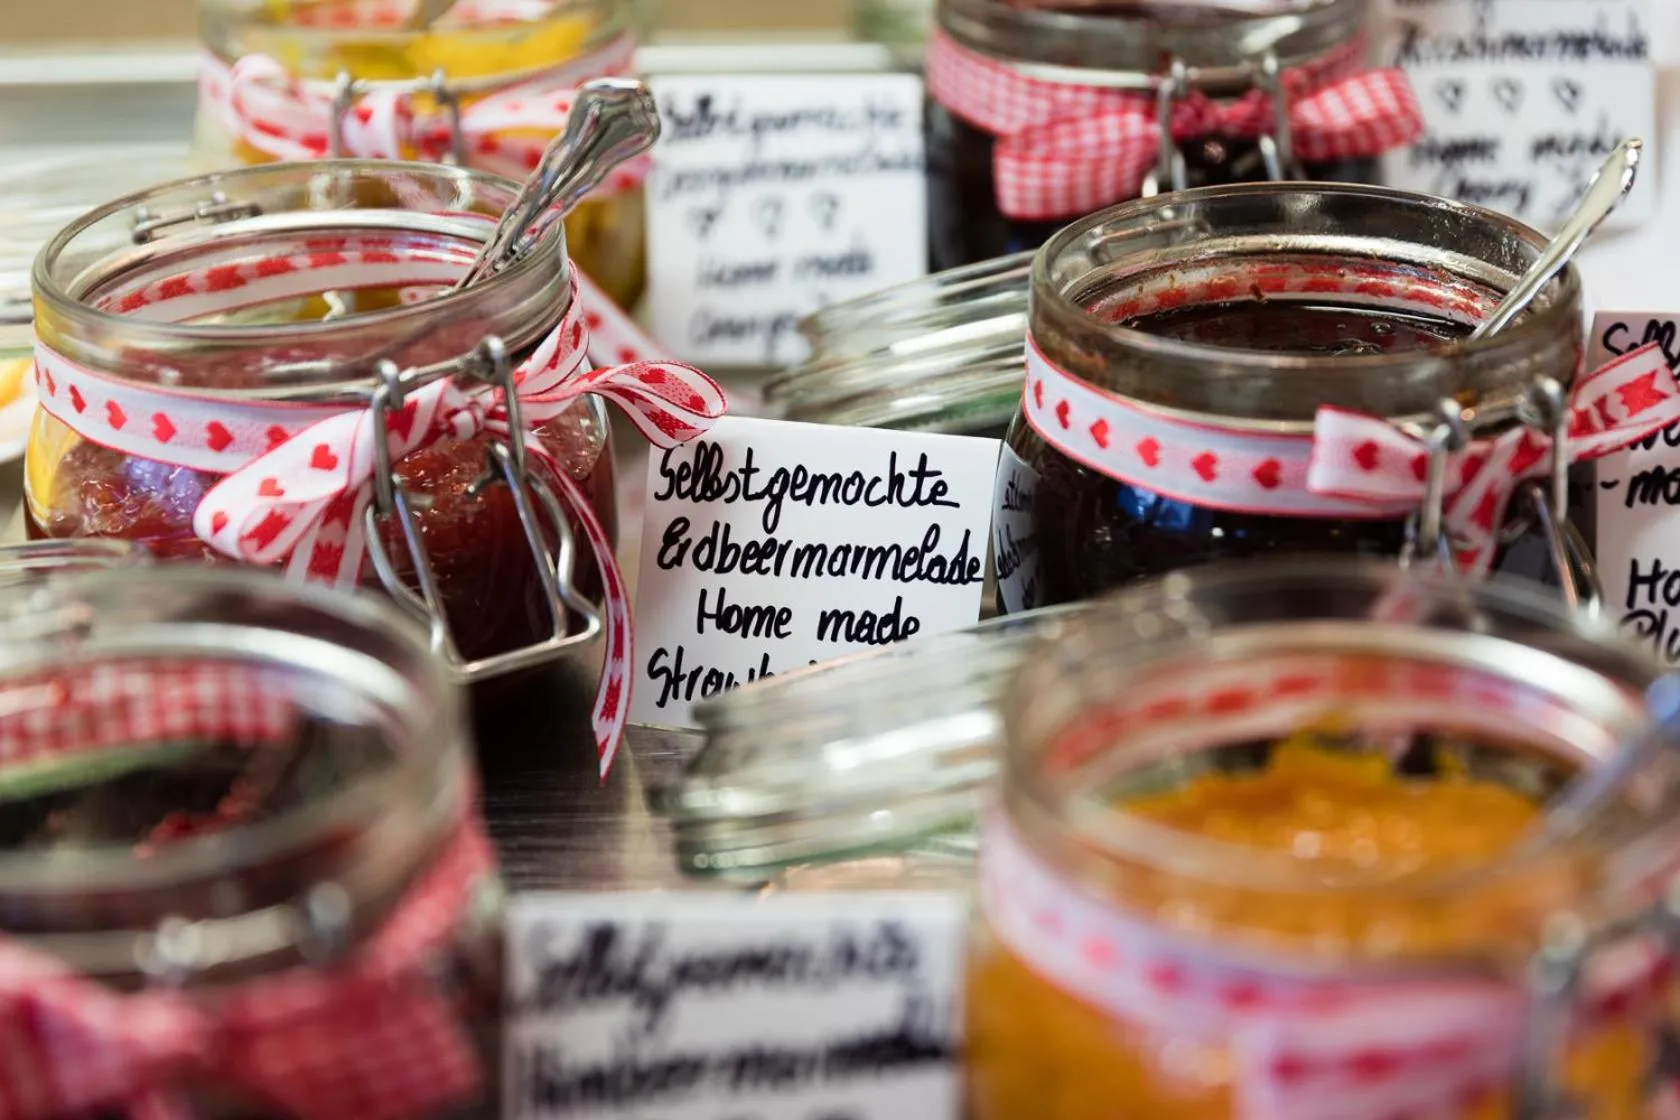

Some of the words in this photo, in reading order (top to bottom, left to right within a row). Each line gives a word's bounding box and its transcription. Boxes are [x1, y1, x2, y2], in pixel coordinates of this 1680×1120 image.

[656, 516, 985, 585] Erdbeermarmelade
[697, 587, 793, 639] Home
[816, 596, 920, 645] made
